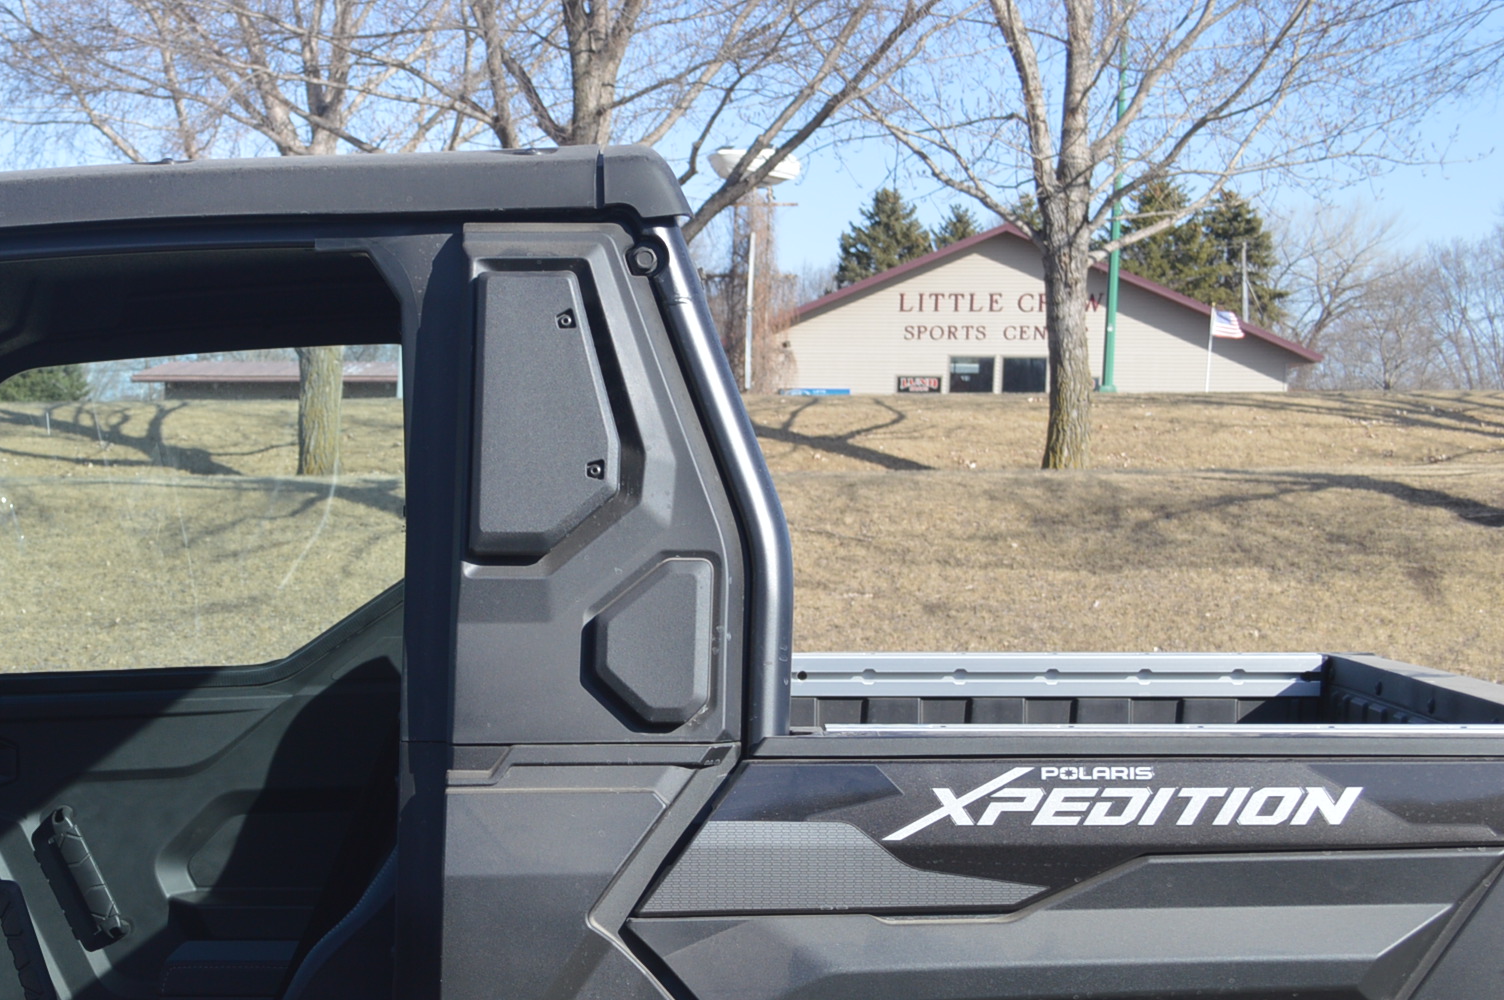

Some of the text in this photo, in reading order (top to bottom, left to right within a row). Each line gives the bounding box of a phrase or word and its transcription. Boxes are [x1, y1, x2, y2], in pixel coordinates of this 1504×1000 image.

[898, 293, 1004, 313] LITTLE
[903, 325, 987, 341] SPORTS
[1041, 766, 1154, 781] POLARIS
[882, 766, 1364, 841] XPEDITION
